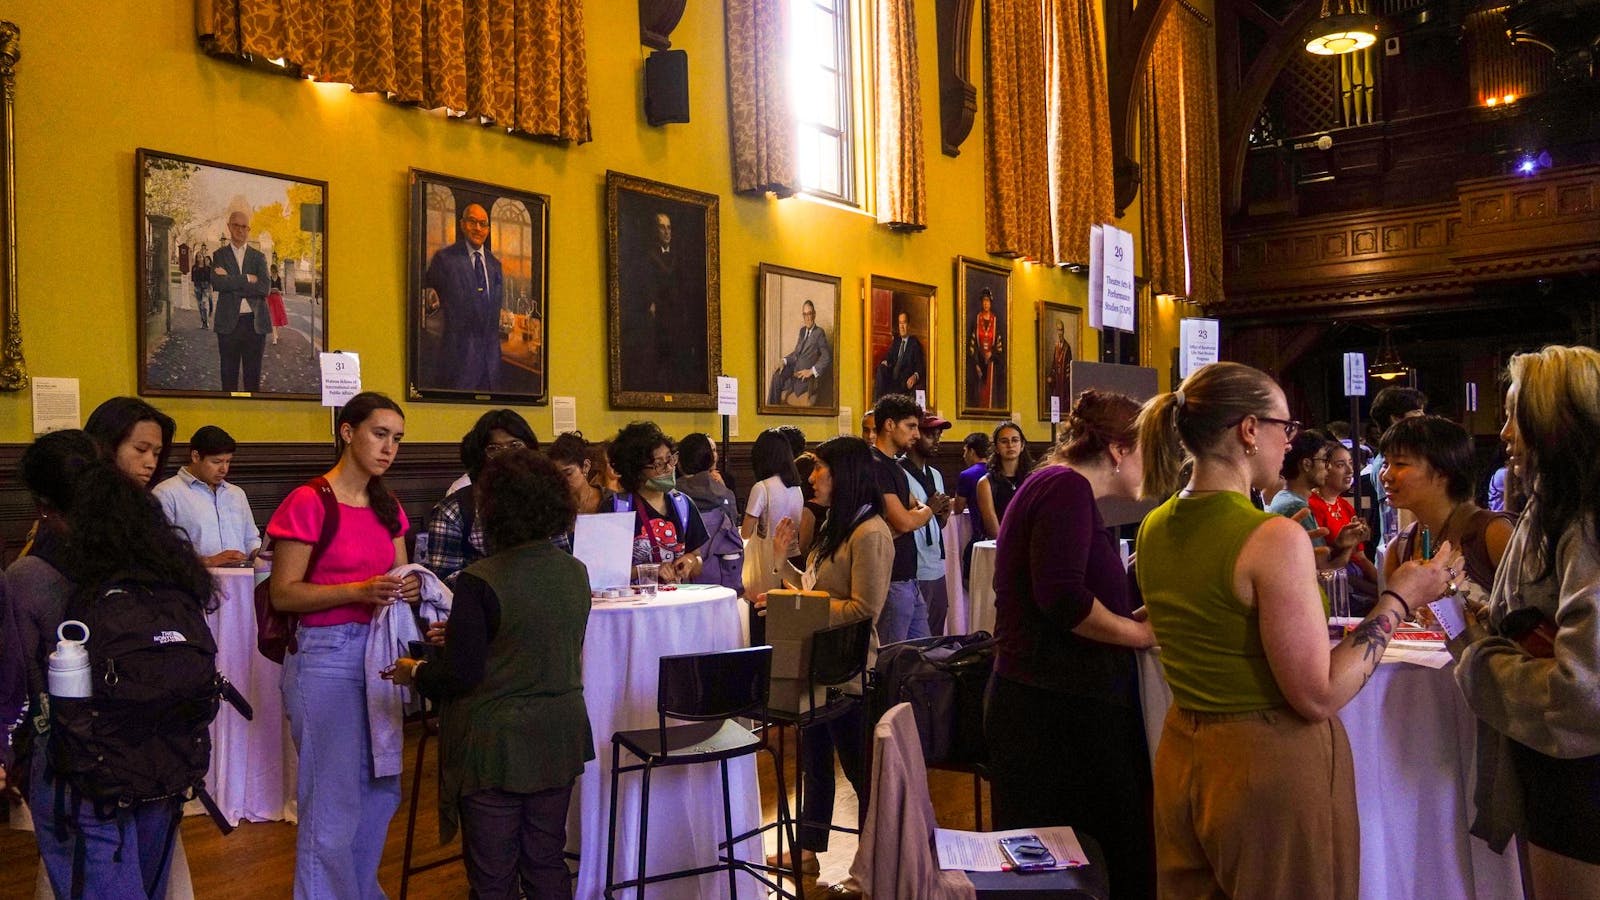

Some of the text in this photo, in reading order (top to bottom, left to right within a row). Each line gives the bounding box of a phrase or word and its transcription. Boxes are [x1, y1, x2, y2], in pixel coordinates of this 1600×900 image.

[1114, 246, 1124, 262] 29
[1106, 275, 1120, 288] Theatre
[1107, 289, 1131, 302] Performance
[1104, 302, 1119, 313] Studies
[1198, 330, 1208, 339] 23
[335, 362, 345, 371] 31
